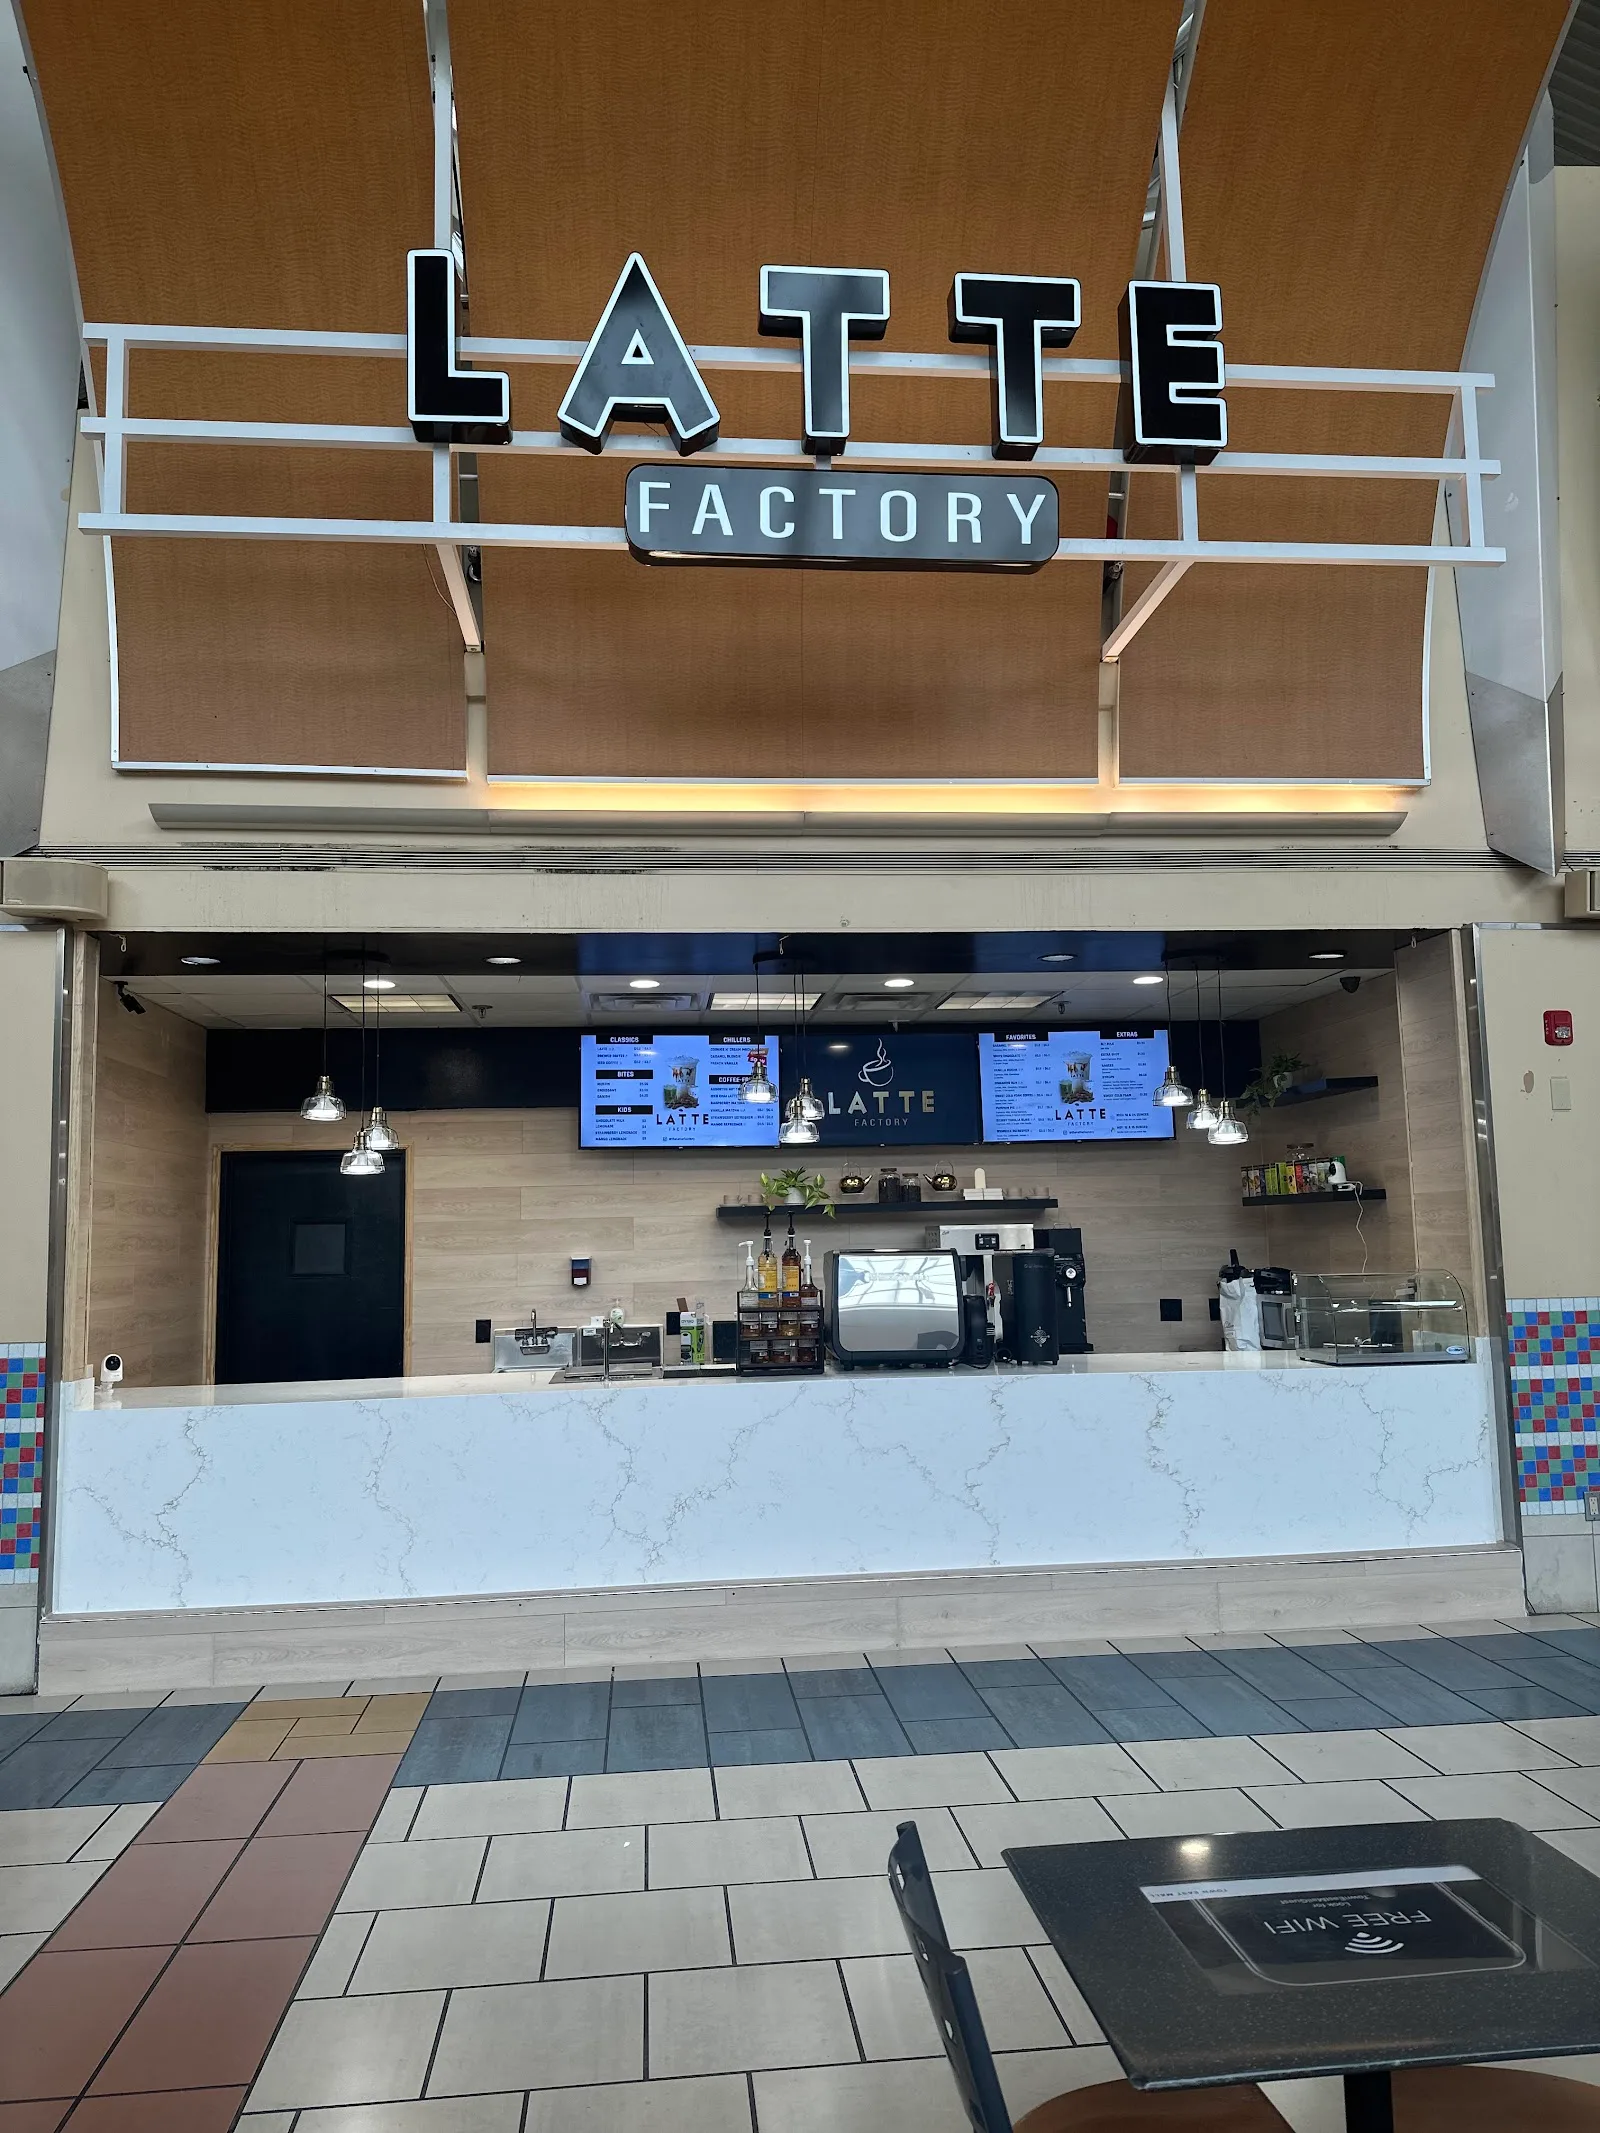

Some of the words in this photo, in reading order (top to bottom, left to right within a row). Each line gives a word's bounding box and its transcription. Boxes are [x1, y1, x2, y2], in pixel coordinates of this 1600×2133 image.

[406, 249, 1228, 455] LATTE
[638, 481, 1046, 544] FACTORY
[828, 1091, 935, 1114] LATTE
[656, 1113, 709, 1125] LATTE
[854, 1118, 909, 1127] FACTORY
[1055, 1108, 1106, 1120] LATTE
[1263, 1915, 1340, 1935] WIFI
[1342, 1909, 1432, 1928] FREE
